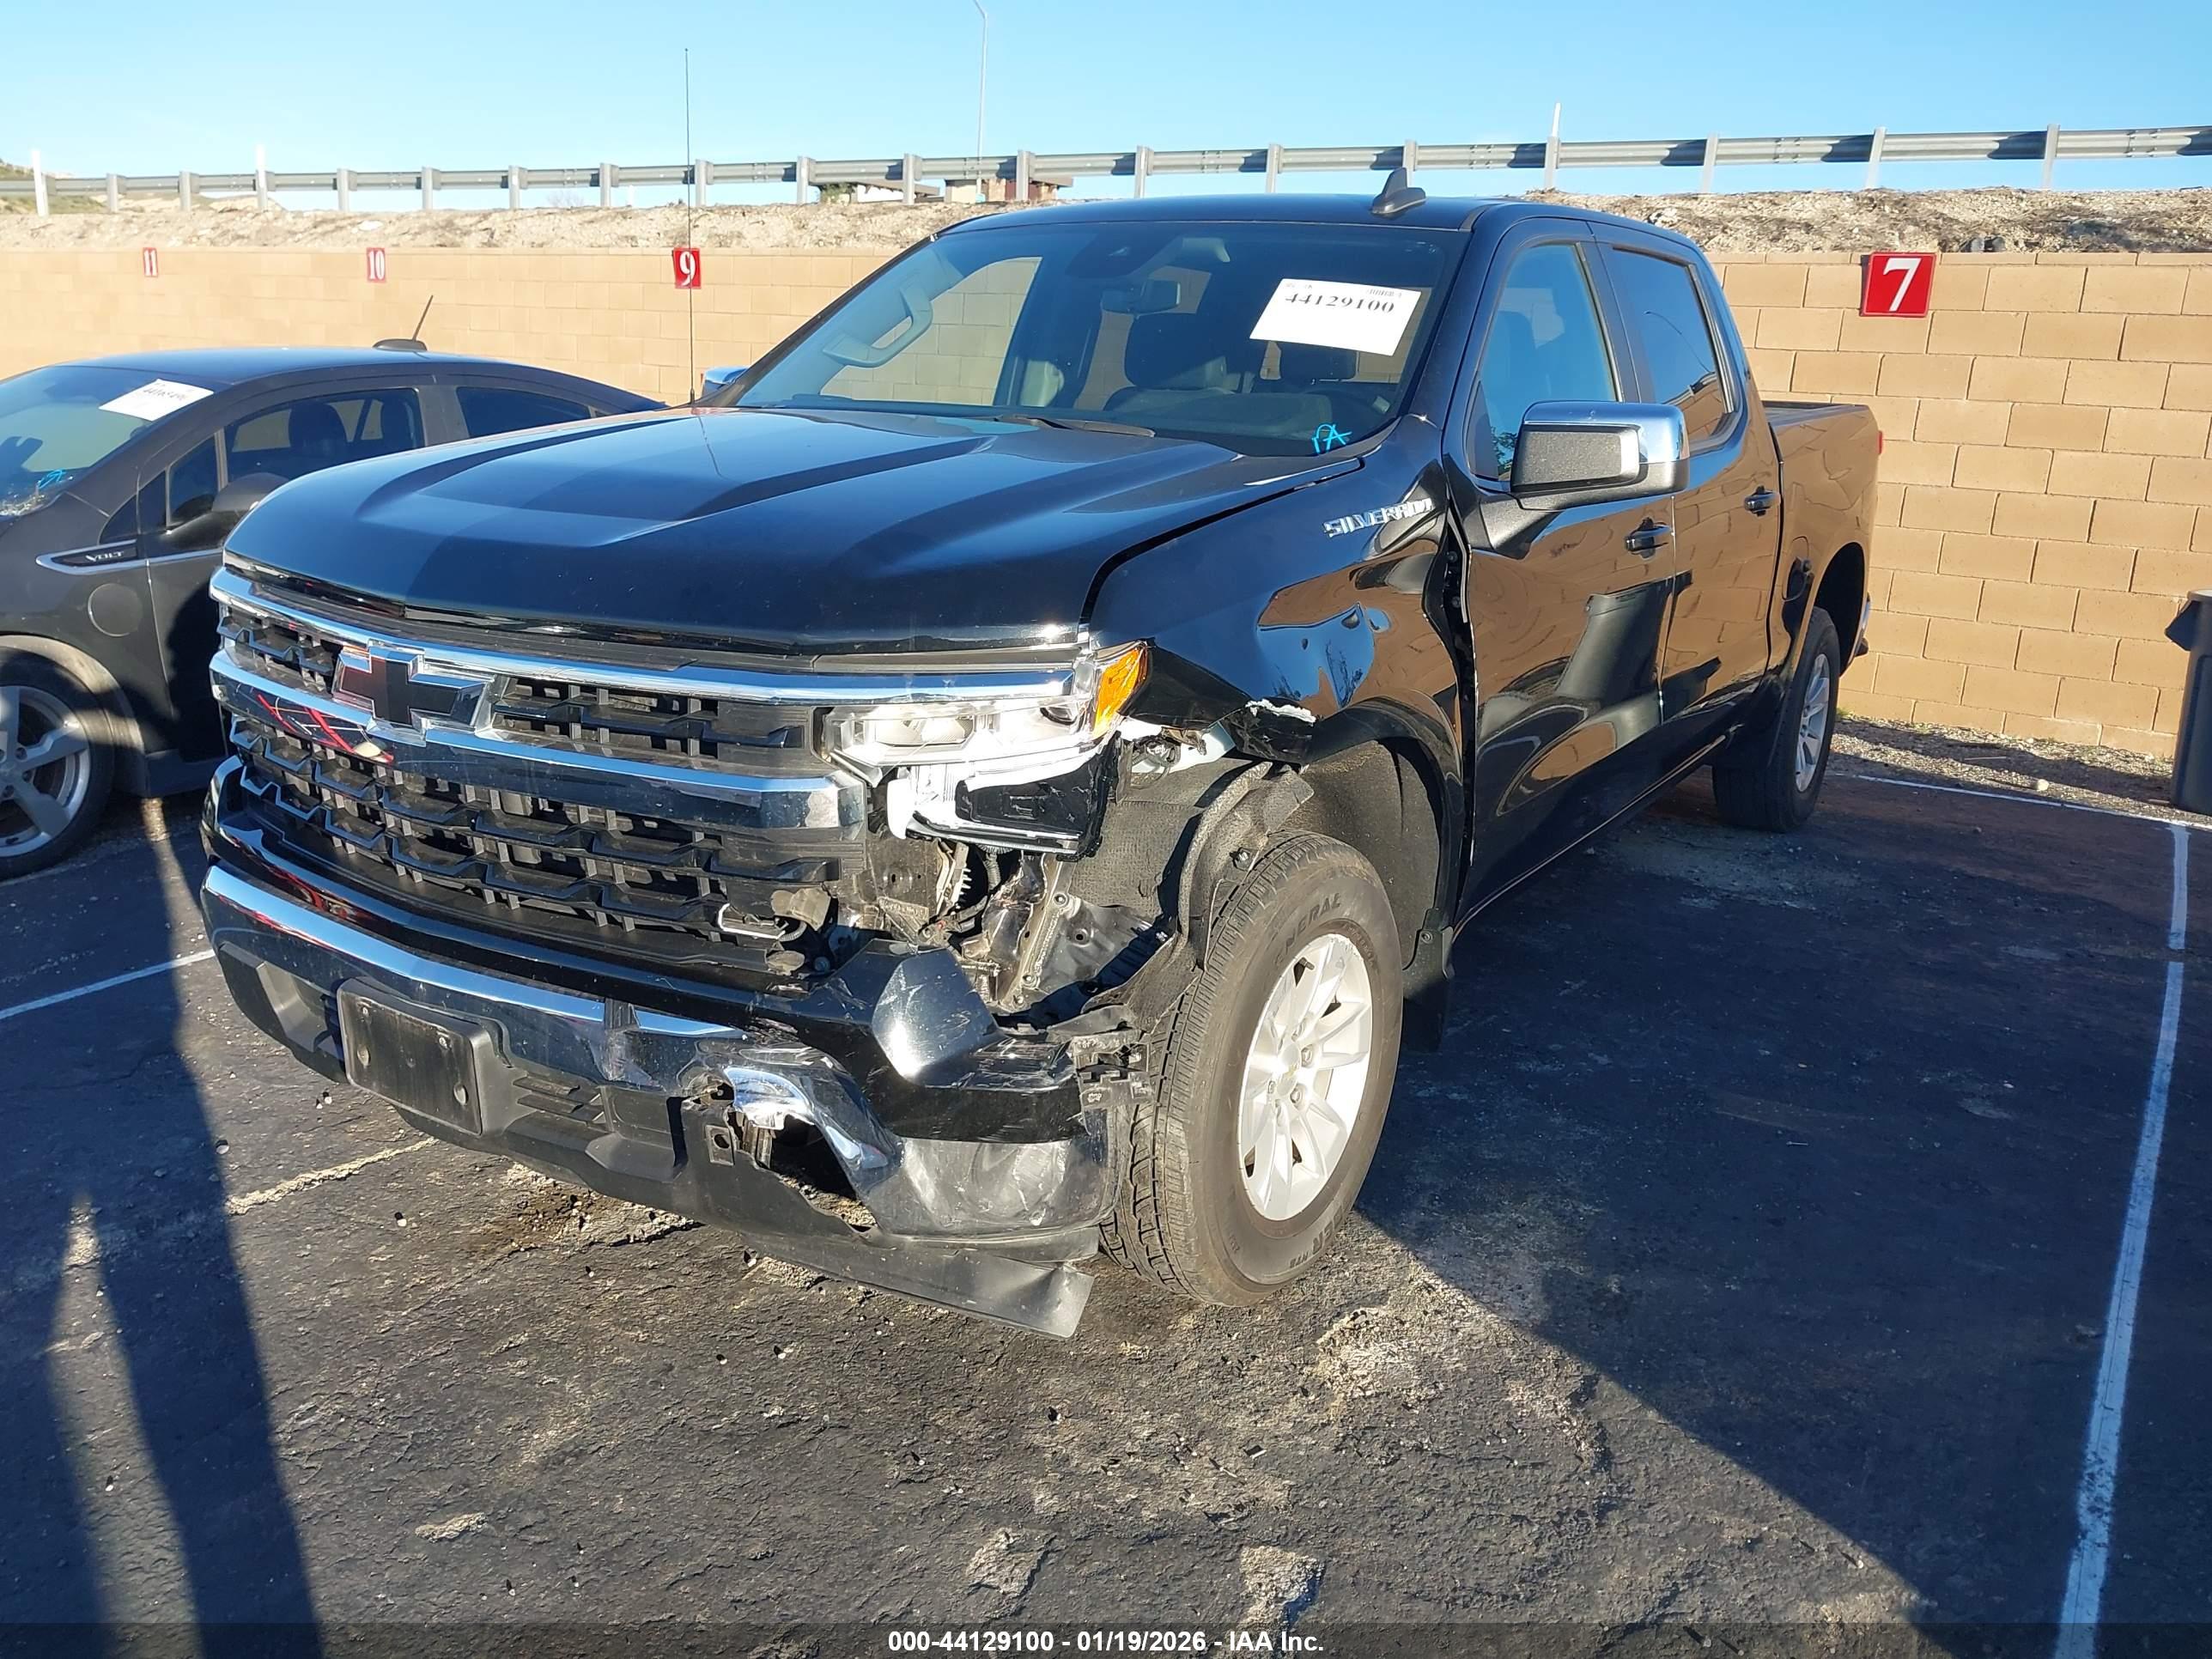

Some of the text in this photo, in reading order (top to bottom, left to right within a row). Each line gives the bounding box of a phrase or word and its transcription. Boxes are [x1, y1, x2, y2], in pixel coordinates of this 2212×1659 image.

[143, 249, 157, 276] 11
[369, 250, 385, 280] 10
[679, 251, 696, 286] 9
[1882, 258, 1922, 312] 7
[1285, 292, 1395, 313] 44129100
